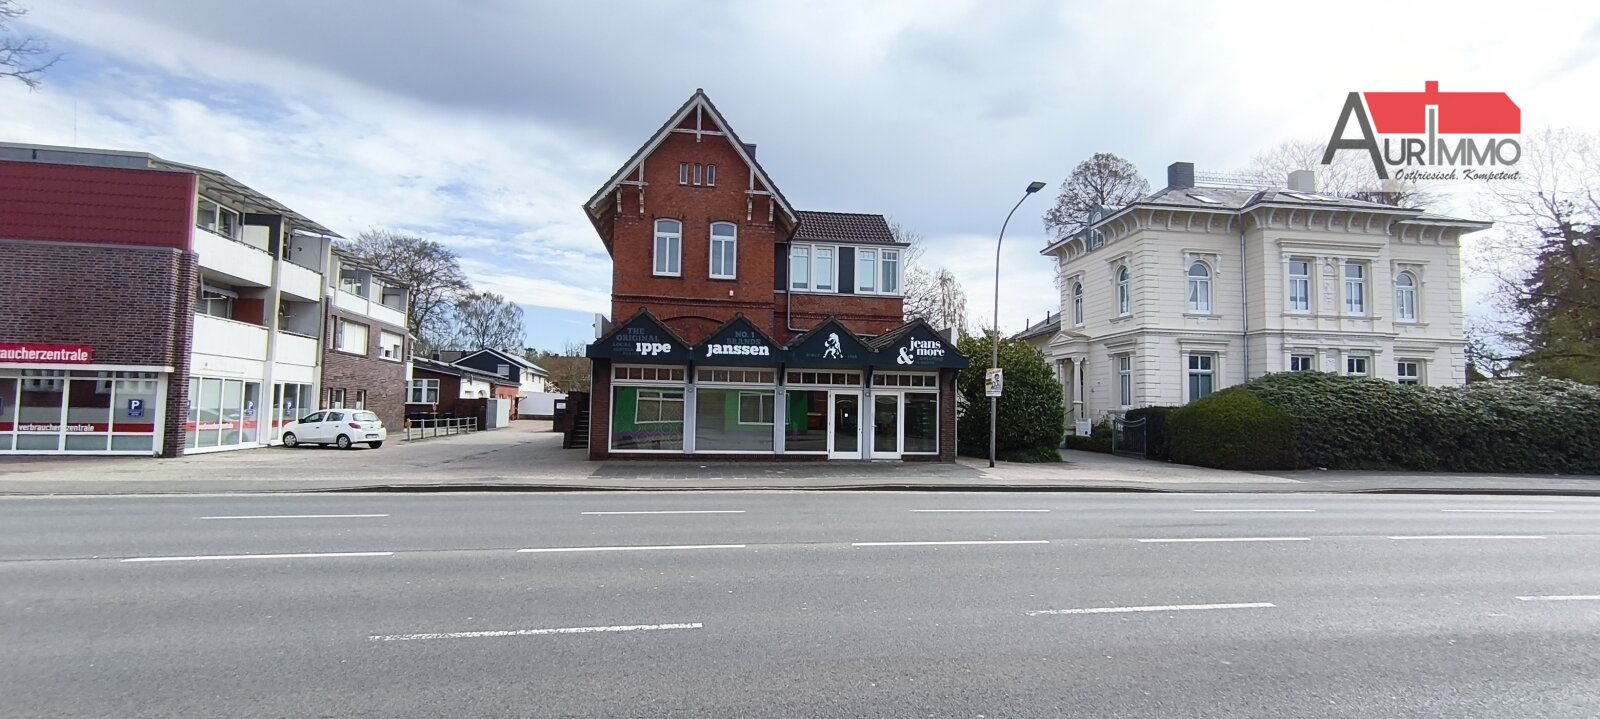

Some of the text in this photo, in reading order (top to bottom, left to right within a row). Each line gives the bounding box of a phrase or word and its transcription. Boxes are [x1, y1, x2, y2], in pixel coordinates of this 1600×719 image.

[706, 344, 770, 357] janssen
[909, 336, 941, 351] jeans
[0, 347, 88, 361] aucherzentrale
[897, 347, 945, 365] & more
[131, 400, 140, 410] P
